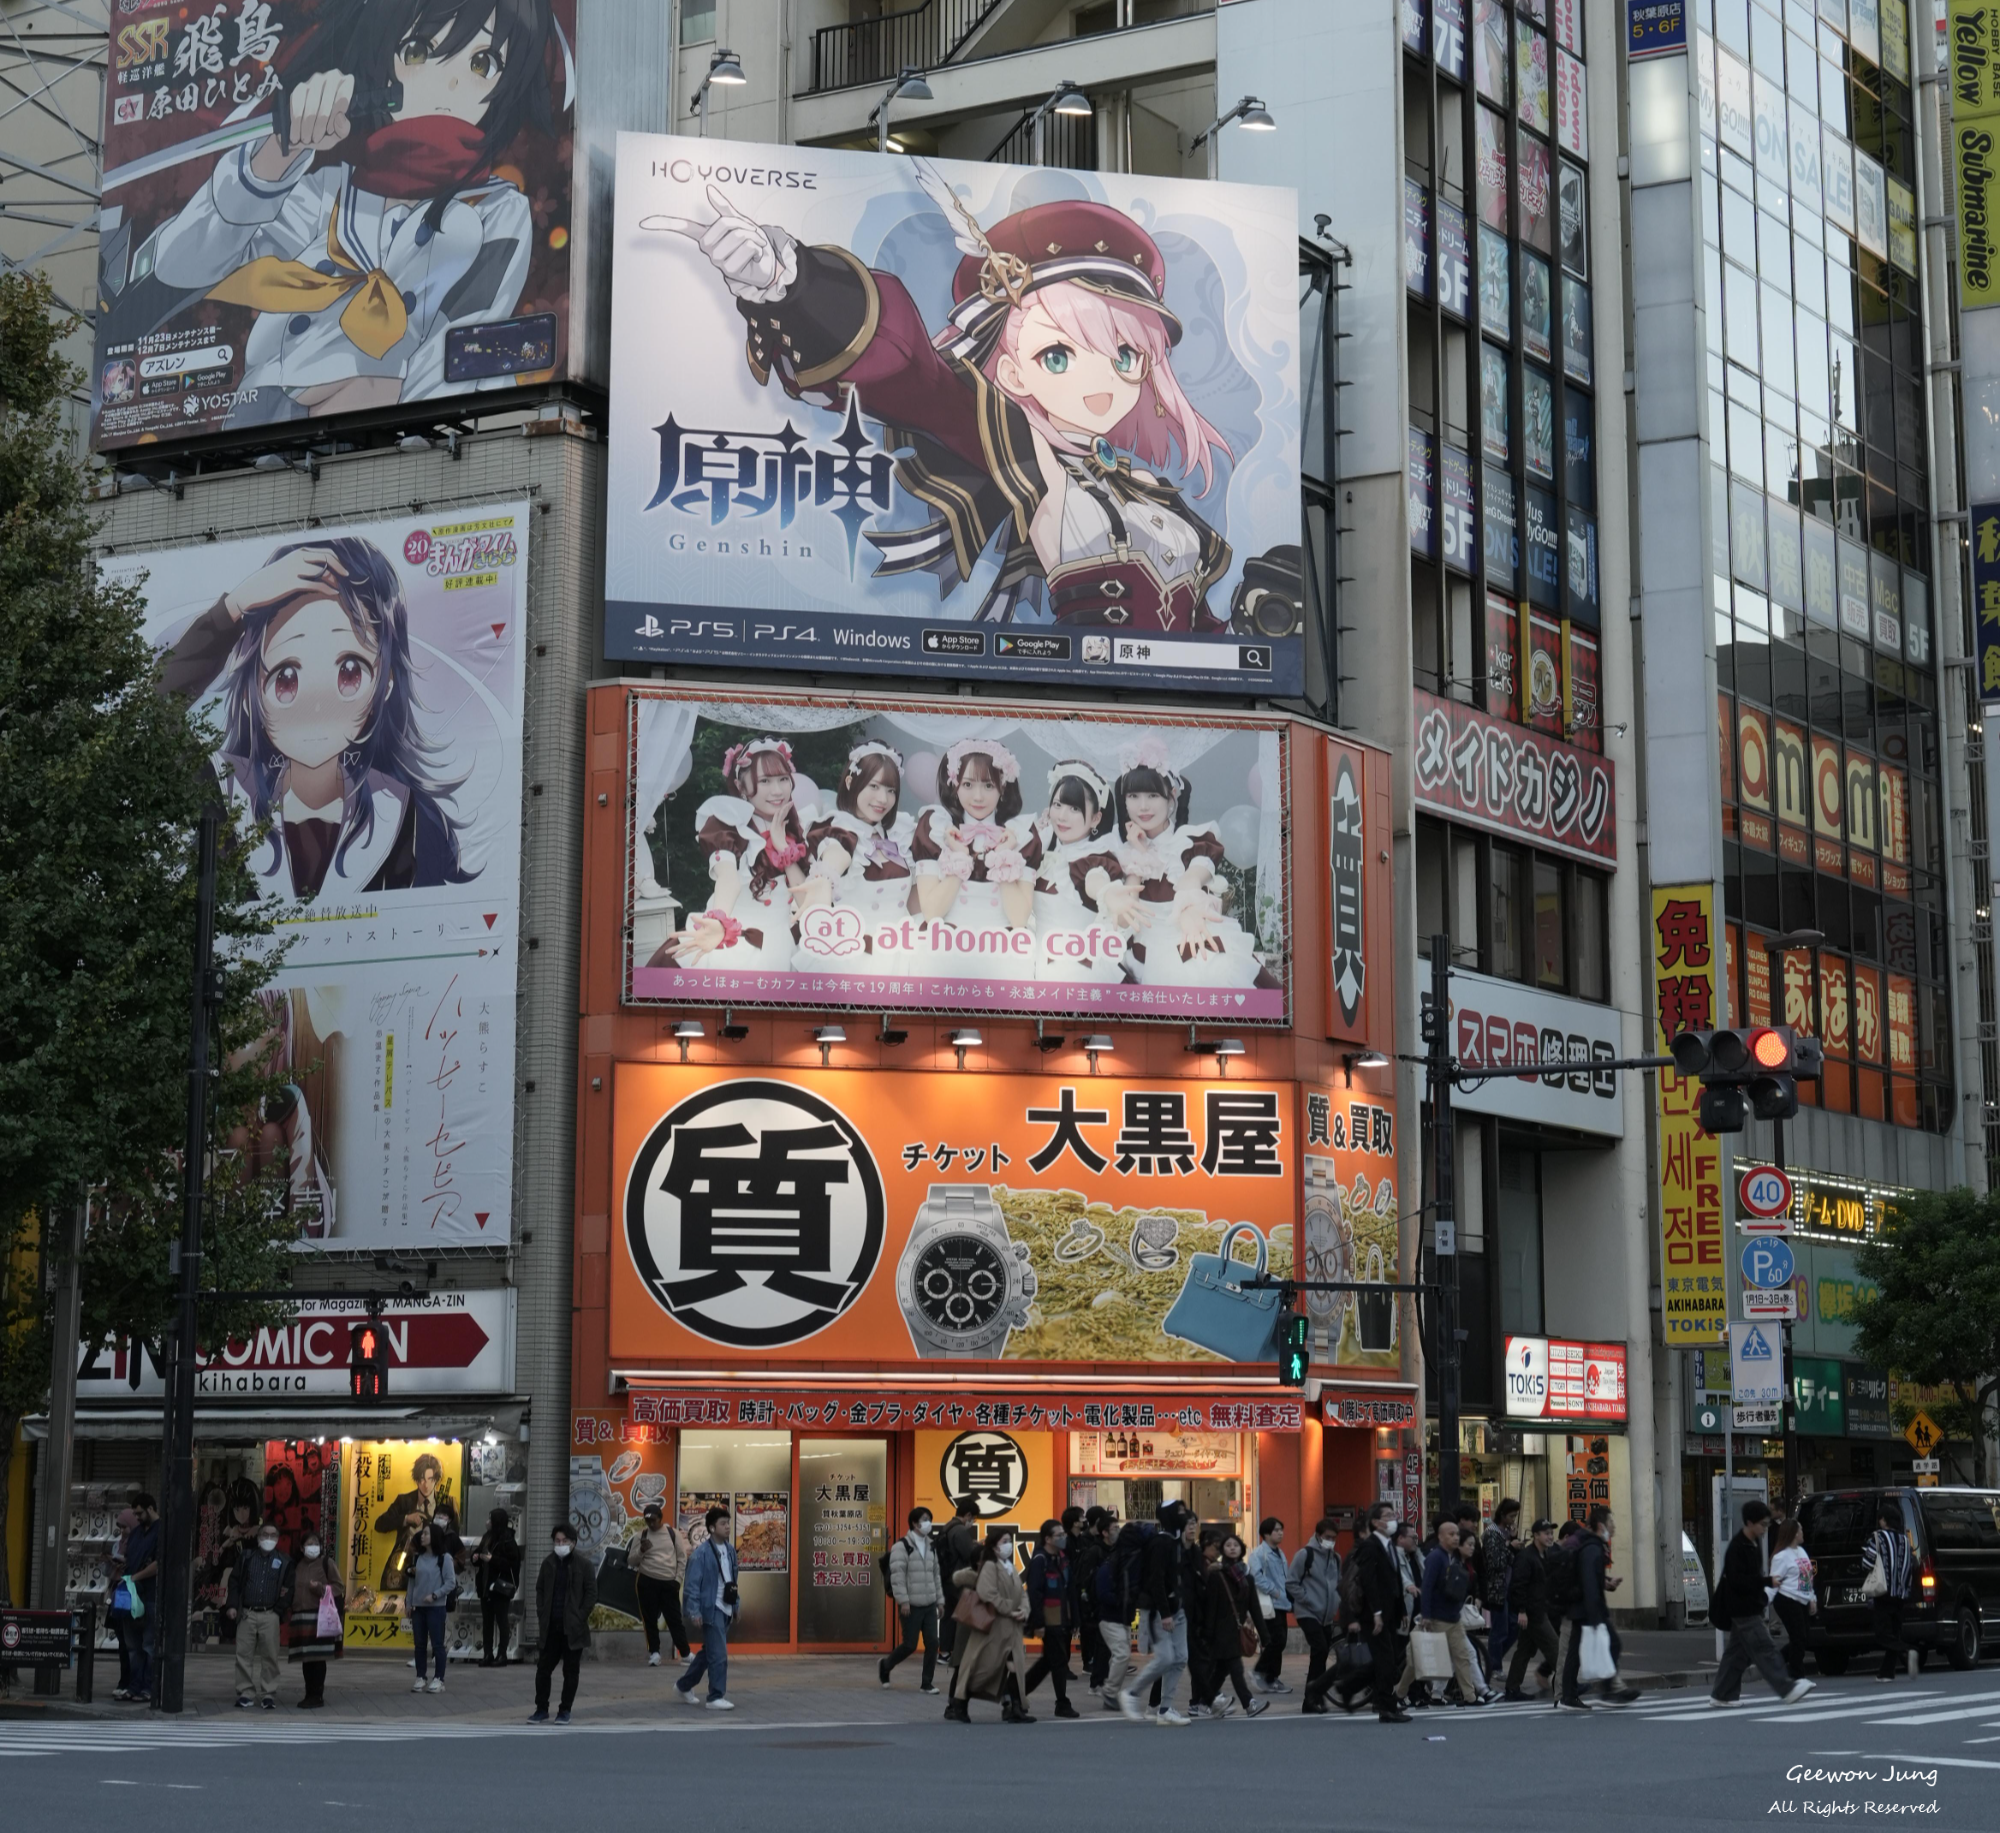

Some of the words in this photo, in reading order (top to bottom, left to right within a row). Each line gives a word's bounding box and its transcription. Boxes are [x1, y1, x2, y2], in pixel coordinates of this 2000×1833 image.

[1633, 3, 1681, 22] 秋葉原店
[116, 17, 170, 69] SSR
[172, 0, 284, 79] 飛鳥
[1990, 8, 2000, 57] HOBBY
[1434, 14, 1464, 75] 7F
[1954, 8, 1987, 107] Yellow
[146, 65, 284, 121] 原田ひとみ
[117, 100, 139, 119] CV
[652, 159, 817, 190] HOYOVERSE
[1755, 114, 1786, 169] ON
[1793, 141, 1851, 216] SALE!
[1958, 127, 1997, 292] Submarine
[1439, 252, 1469, 310] 6F
[145, 357, 186, 375] アズレン
[197, 372, 215, 381] Google
[216, 370, 226, 380] Play
[151, 381, 162, 390] App
[163, 379, 177, 388] Store
[201, 389, 259, 411] YOSTAR
[642, 388, 895, 584] 原神
[1443, 503, 1474, 561] 5F
[407, 538, 428, 557] 20
[668, 534, 813, 558] Genshin
[1485, 525, 1507, 563] ON
[1736, 511, 1833, 616] 秋葉館
[1843, 562, 1867, 598] 中古
[1874, 576, 1899, 614] Mac
[670, 619, 735, 638] PS5
[754, 624, 818, 642] PS4
[833, 628, 911, 649] Windows
[942, 634, 960, 646] App
[961, 636, 980, 645] Store
[1878, 614, 1898, 644] 買取
[942, 644, 979, 652] からダウンロード
[1016, 638, 1042, 650] Google
[1043, 640, 1060, 651] Play
[1016, 648, 1052, 656] で手に入れよう
[1119, 644, 1151, 661] 原神
[1908, 622, 1930, 661] 5F
[1415, 709, 1609, 845] メイドカジノ
[1330, 795, 1366, 998] 質
[818, 917, 845, 938] at
[877, 920, 1032, 954] at-home
[1046, 927, 1123, 957] cafe
[478, 1001, 490, 1093] 大熊らすこ
[1459, 1012, 1616, 1098] スマホ修理王
[1890, 1029, 1911, 1064] 買取
[422, 974, 466, 1229] ハッピーセピア
[1025, 1087, 1283, 1177] 大黒屋
[1307, 1092, 1394, 1158] 質&買取
[901, 1142, 1011, 1173] チケット
[1752, 1181, 1780, 1203] 40
[652, 1120, 859, 1314] 質
[1694, 1155, 1722, 1265] FREE
[1756, 1238, 1779, 1248] 9-19
[1666, 1276, 1724, 1294] 東京電気
[1767, 1268, 1783, 1283] 60
[301, 1298, 317, 1311] for
[392, 1294, 466, 1310] MANGA-ZIN
[1666, 1297, 1725, 1312] AKIHABARA
[1668, 1316, 1725, 1333] TOKiS
[1566, 1349, 1583, 1359] SEIKO
[198, 1373, 307, 1391] kihabara
[1509, 1373, 1544, 1396] TOKiS
[1555, 1382, 1566, 1390] TIGER
[1617, 1362, 1625, 1399] 免税
[1568, 1400, 1584, 1408] SONY
[1738, 1388, 1756, 1399] この先
[1761, 1387, 1779, 1399] 30m
[633, 1396, 731, 1424] 高価買取
[1210, 1402, 1302, 1428] 無料査定
[1340, 1400, 1414, 1423] 1階にて高価買取中
[1736, 1409, 1778, 1423] 歩行者優先
[951, 1441, 1020, 1507] 質
[1406, 1454, 1418, 1473] 4F
[816, 1484, 870, 1502] 大黒屋
[1567, 1478, 1609, 1500] 高価
[813, 1552, 871, 1567] 質&買取
[813, 1571, 871, 1586] 査定入口
[347, 1623, 400, 1643] ハルタ
